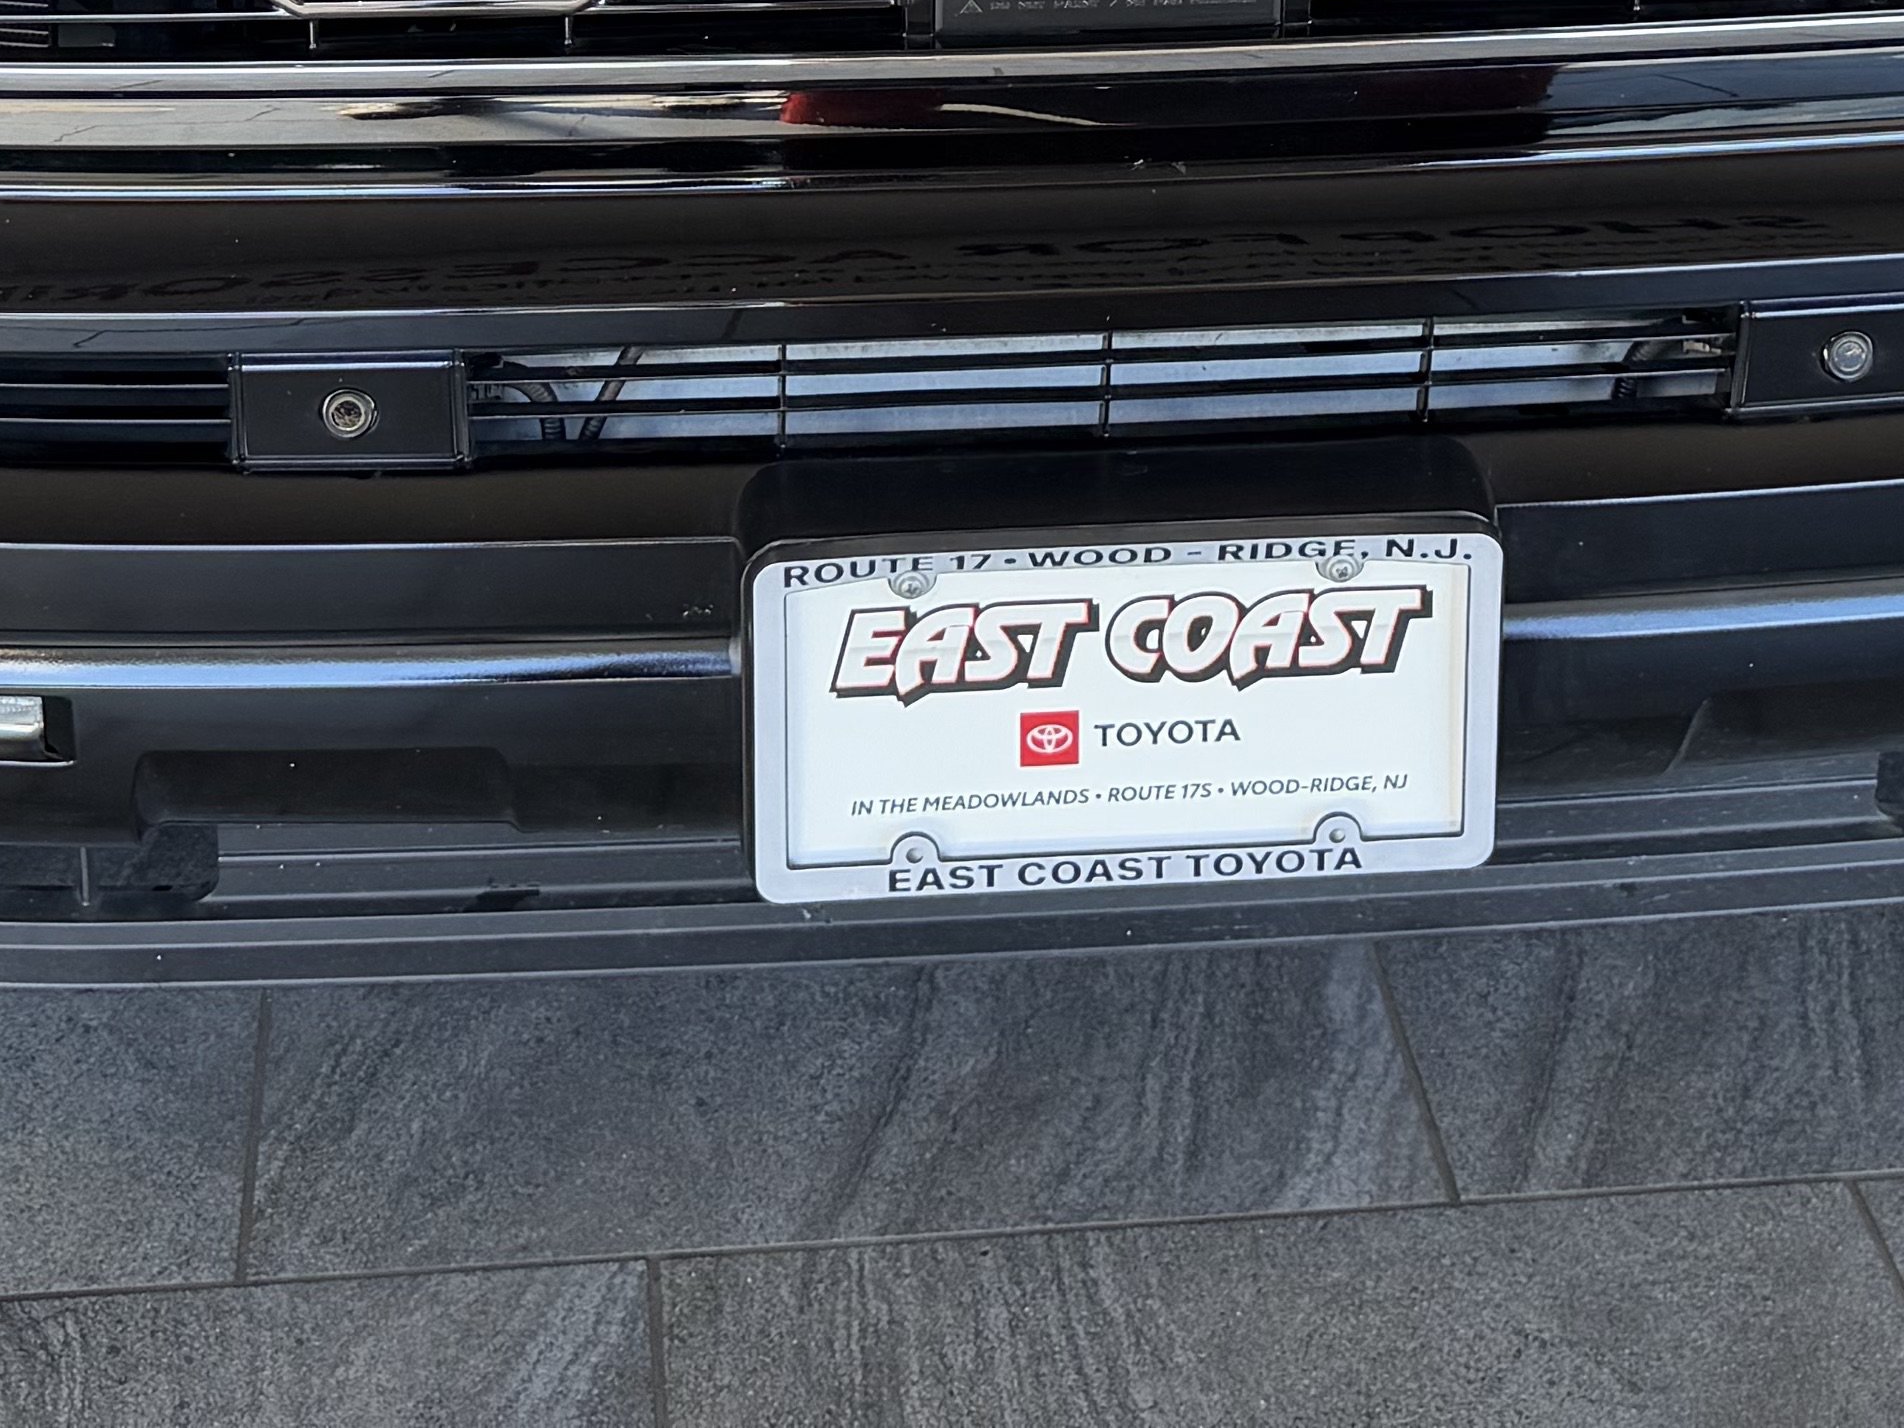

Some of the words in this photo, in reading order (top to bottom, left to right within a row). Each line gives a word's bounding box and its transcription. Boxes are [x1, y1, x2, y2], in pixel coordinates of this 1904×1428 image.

[783, 555, 934, 588] ROUTE
[949, 553, 992, 570] 17
[1027, 546, 1172, 568] WOOD
[1217, 539, 1370, 561] RIDGE,
[1385, 538, 1473, 560] N.J.
[829, 598, 1100, 705] EAST
[1104, 584, 1433, 692] COAST
[1093, 718, 1241, 748] TOYOTA
[850, 800, 874, 816] IN
[879, 797, 918, 813] THE
[922, 788, 1090, 812] MEADOWLANDS
[1107, 784, 1176, 803] ROUTE
[1182, 782, 1212, 799] 17S
[1230, 775, 1377, 797] WOOD-RIDGE,
[1383, 773, 1409, 790] NJ
[888, 864, 1004, 893] EAST
[1017, 855, 1172, 887] COAST
[1185, 846, 1362, 878] TOYOTA
